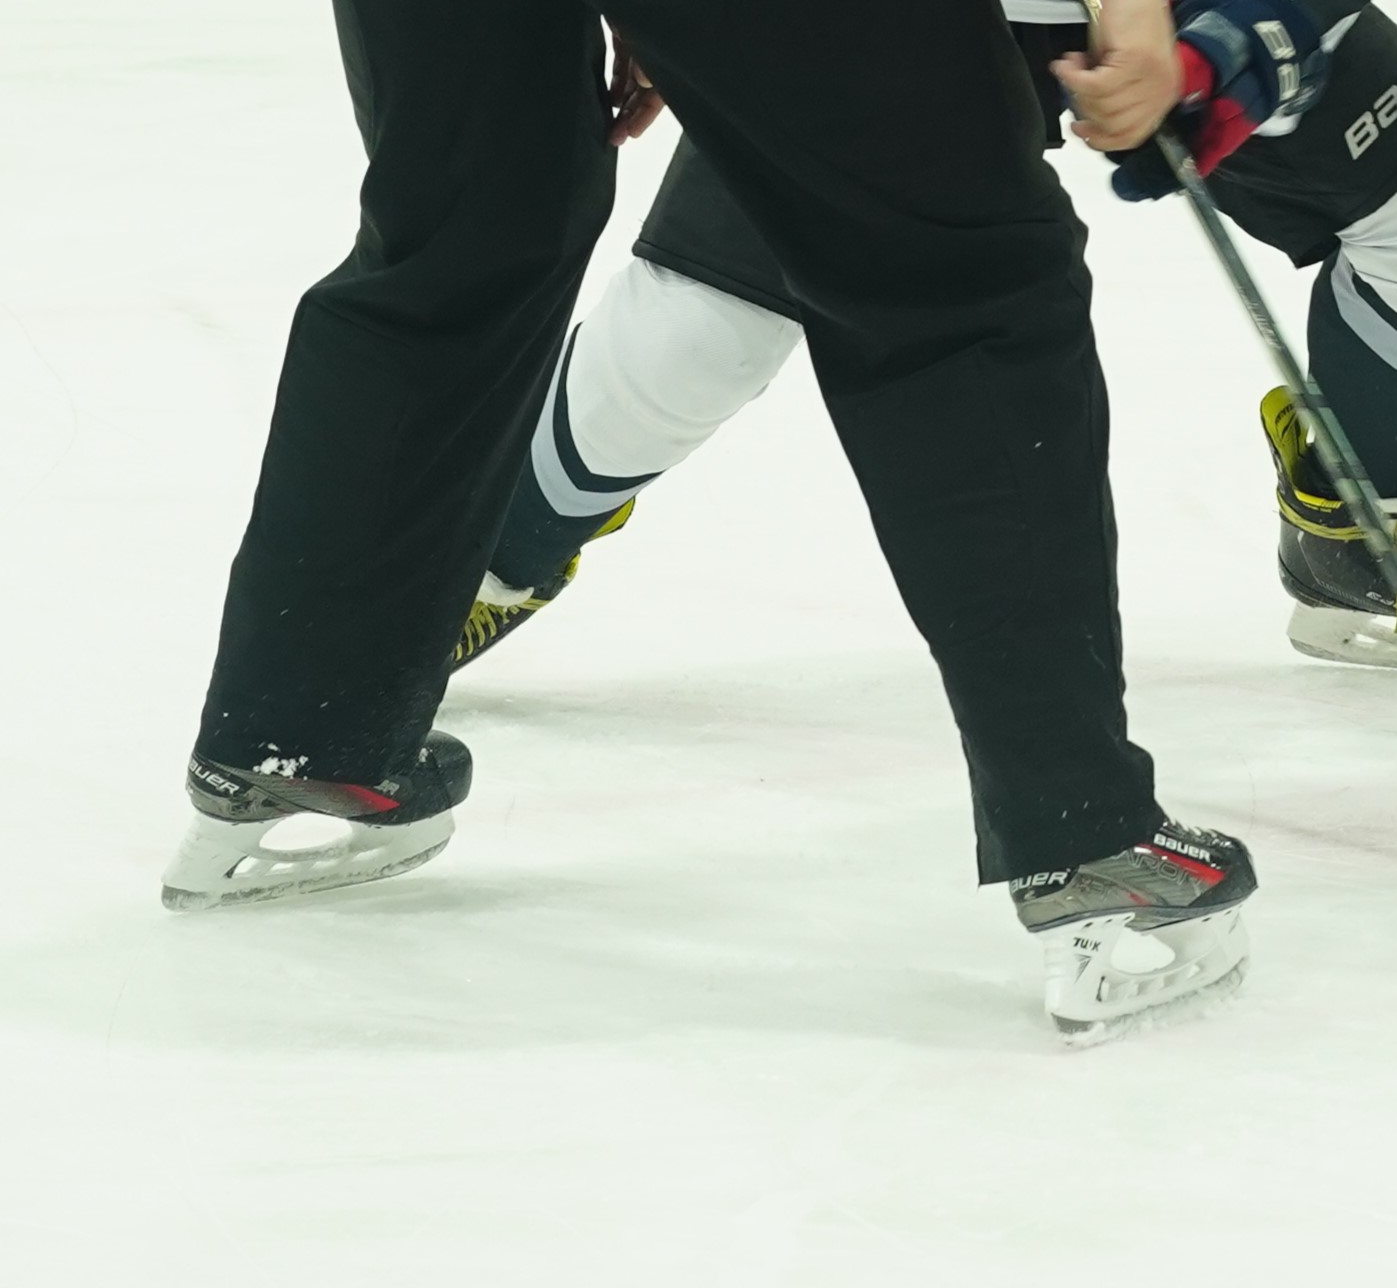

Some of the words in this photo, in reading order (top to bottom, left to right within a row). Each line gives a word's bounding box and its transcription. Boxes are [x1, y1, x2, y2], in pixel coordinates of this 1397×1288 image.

[188, 758, 240, 795] AUER
[1153, 833, 1212, 863] BAUER
[1010, 867, 1071, 895] AUER
